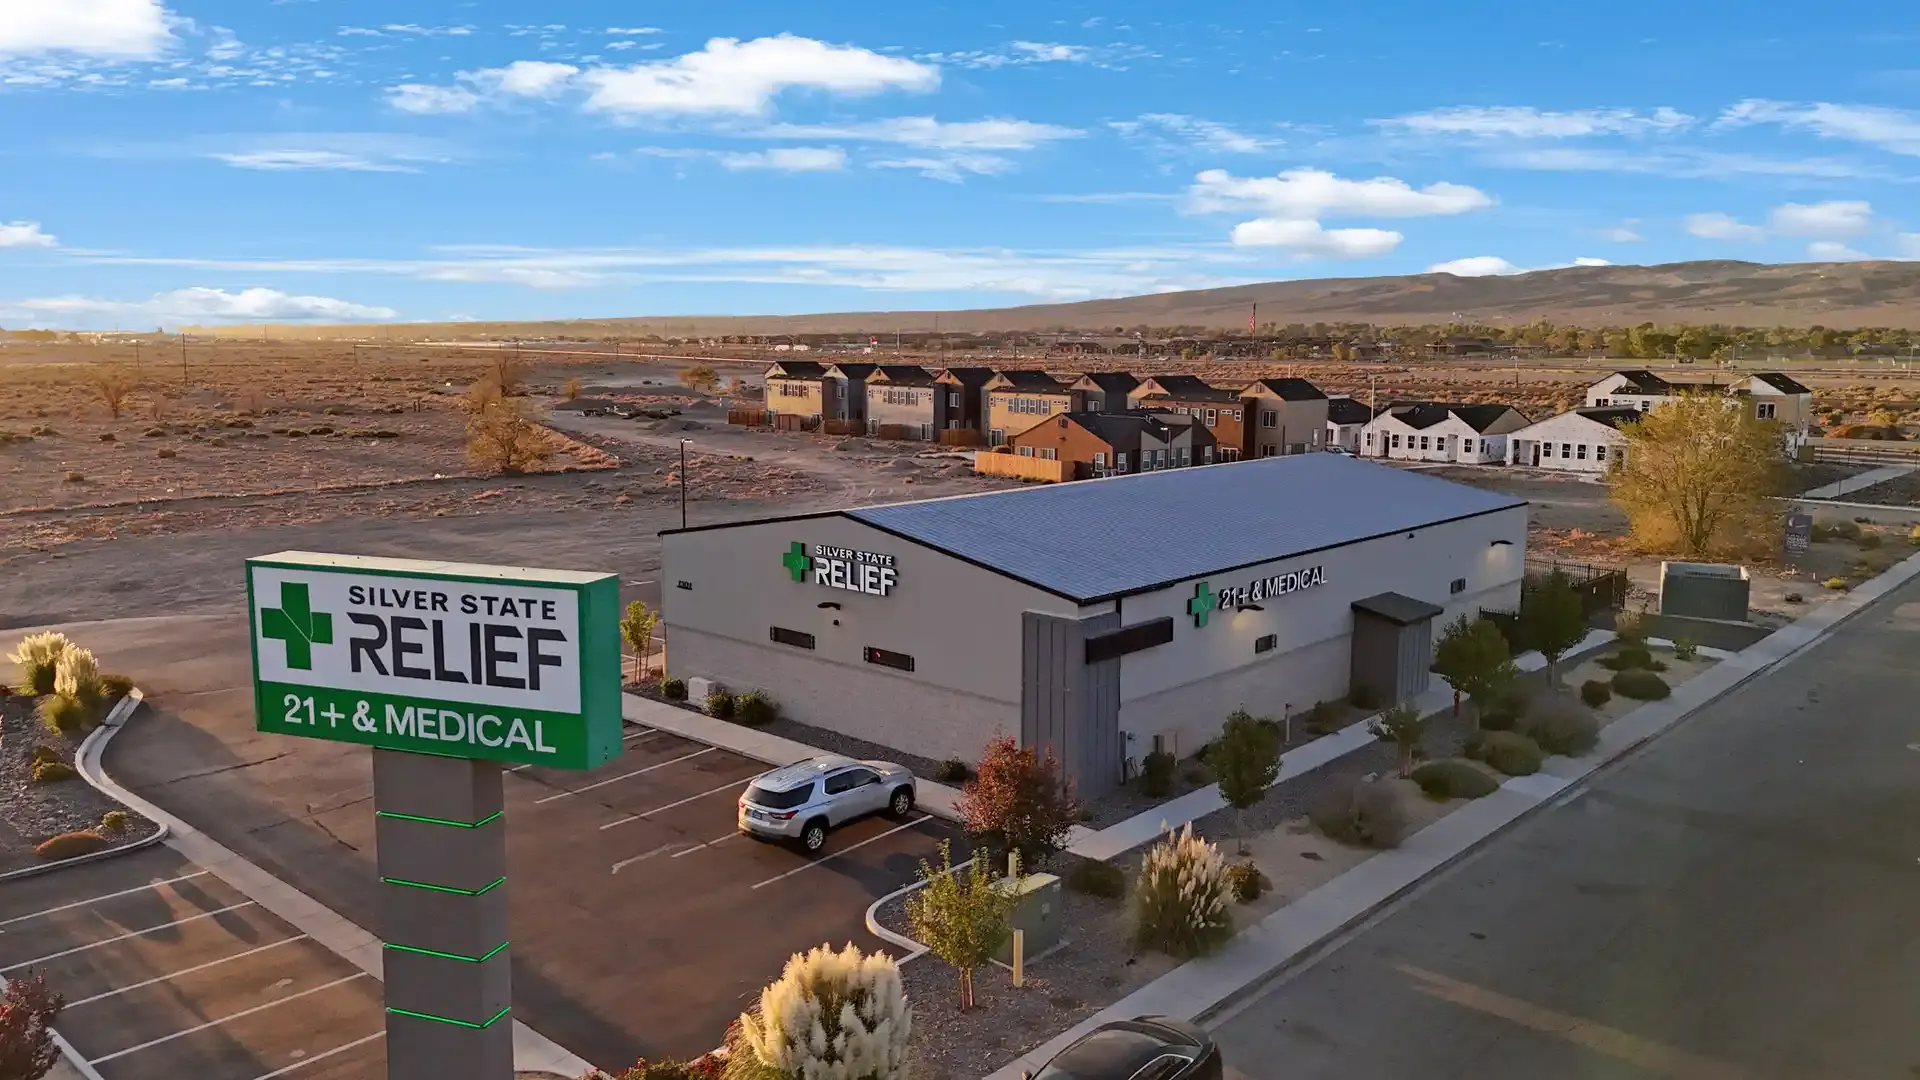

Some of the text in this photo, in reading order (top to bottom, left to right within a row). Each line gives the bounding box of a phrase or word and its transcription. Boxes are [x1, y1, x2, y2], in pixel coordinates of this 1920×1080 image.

[815, 545, 893, 566] SILVER STATE
[815, 557, 896, 596] RELIEF
[1222, 566, 1328, 609] 21+ & MEDICAL
[348, 585, 557, 621] SILVER STATE
[346, 611, 568, 691] RELIEF
[283, 694, 557, 754] 21+ & MEDICAL
